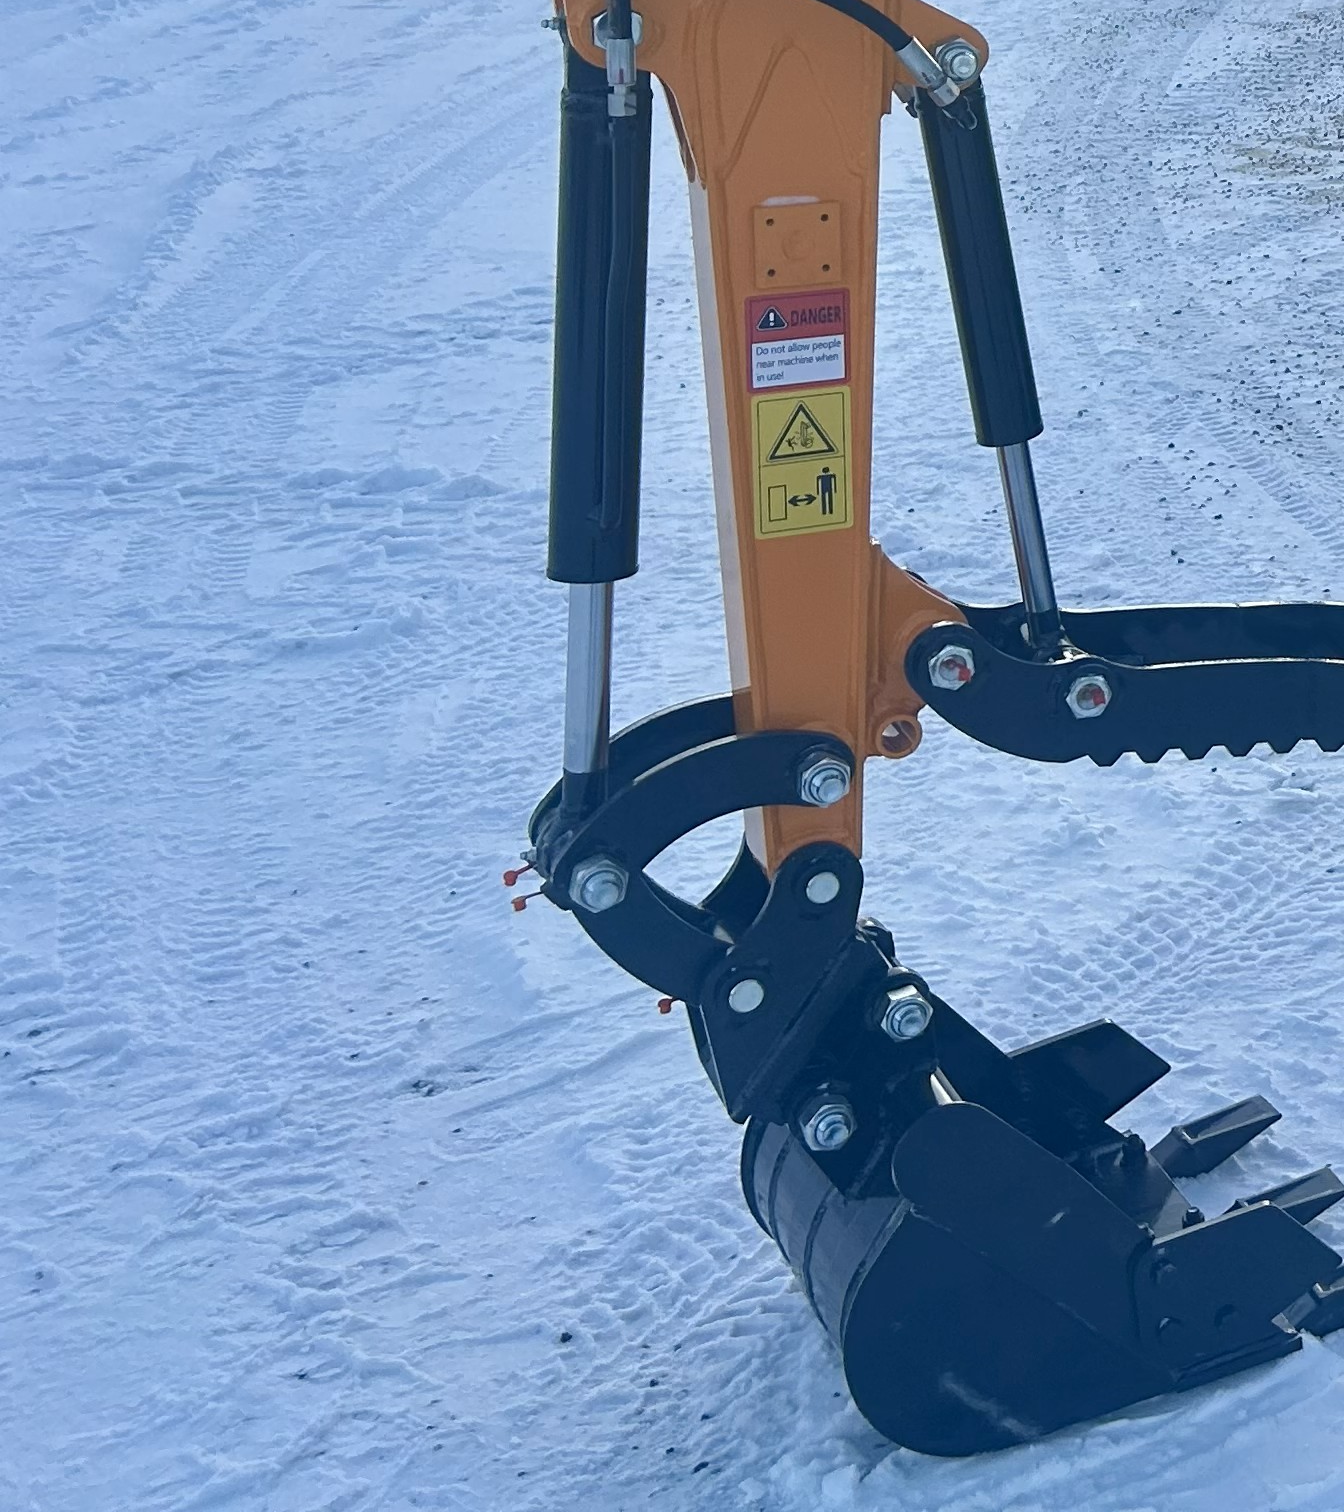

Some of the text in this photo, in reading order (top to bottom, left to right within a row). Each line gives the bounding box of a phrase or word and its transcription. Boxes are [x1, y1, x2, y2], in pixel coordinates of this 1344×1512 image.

[791, 306, 842, 327] DANGER
[756, 339, 842, 356] Do not allow people
[756, 353, 839, 369] near machine when
[756, 374, 765, 382] in
